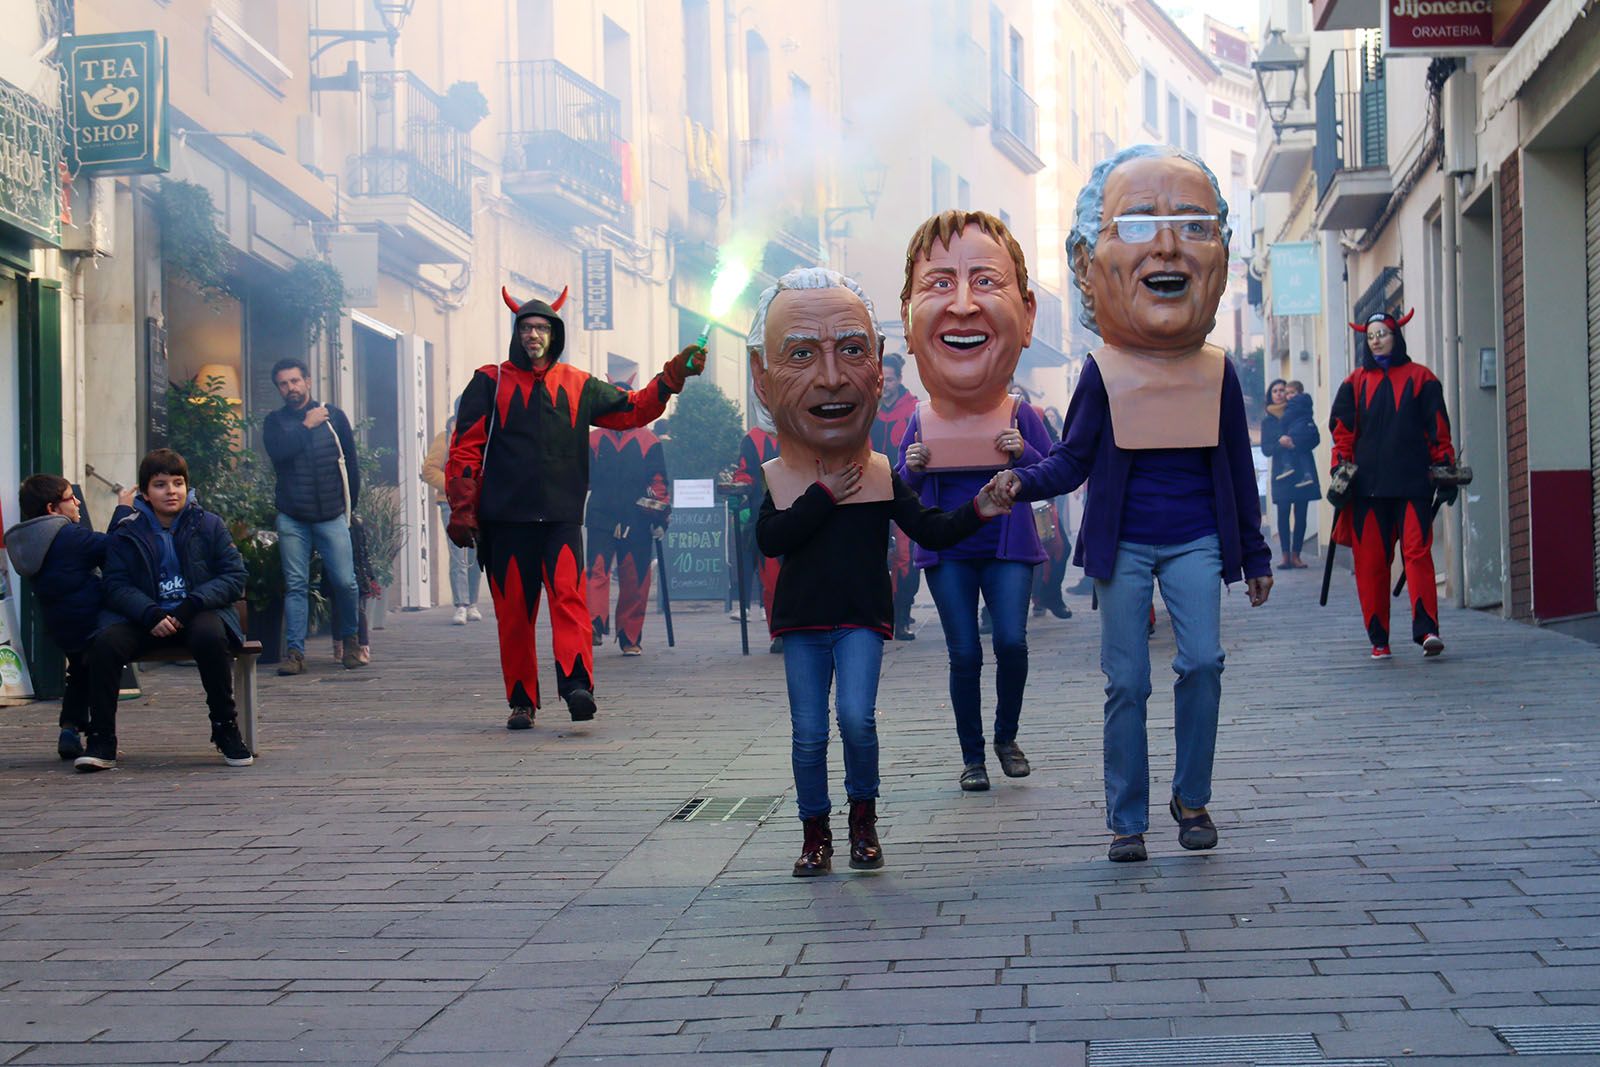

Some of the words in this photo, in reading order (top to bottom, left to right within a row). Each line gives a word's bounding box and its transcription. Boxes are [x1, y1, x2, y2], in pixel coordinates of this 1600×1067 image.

[1411, 25, 1481, 38] ORXATERIA
[80, 57, 139, 81] TEA
[82, 123, 139, 144] SHOP
[672, 552, 692, 573] 10
[695, 558, 722, 573] DTE
